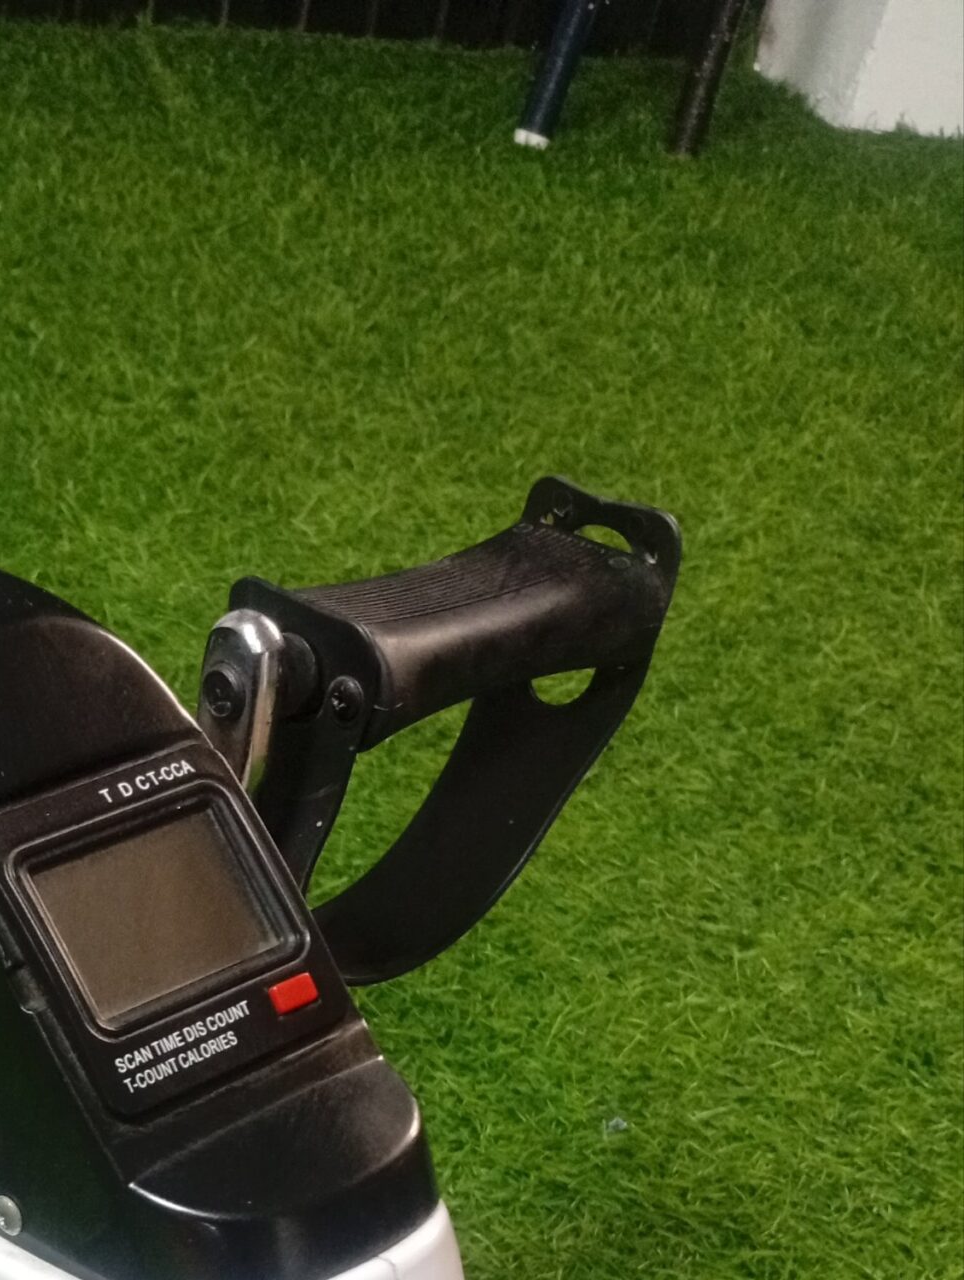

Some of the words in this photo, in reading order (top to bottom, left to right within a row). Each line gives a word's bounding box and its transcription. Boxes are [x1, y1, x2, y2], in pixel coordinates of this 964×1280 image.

[114, 1045, 153, 1074] SCAN
[151, 1031, 185, 1057] TIME
[183, 1021, 208, 1042] DIS
[205, 1000, 251, 1032] COUNT
[123, 1057, 180, 1094] T-COUNT
[177, 1030, 239, 1069] CALORIES
